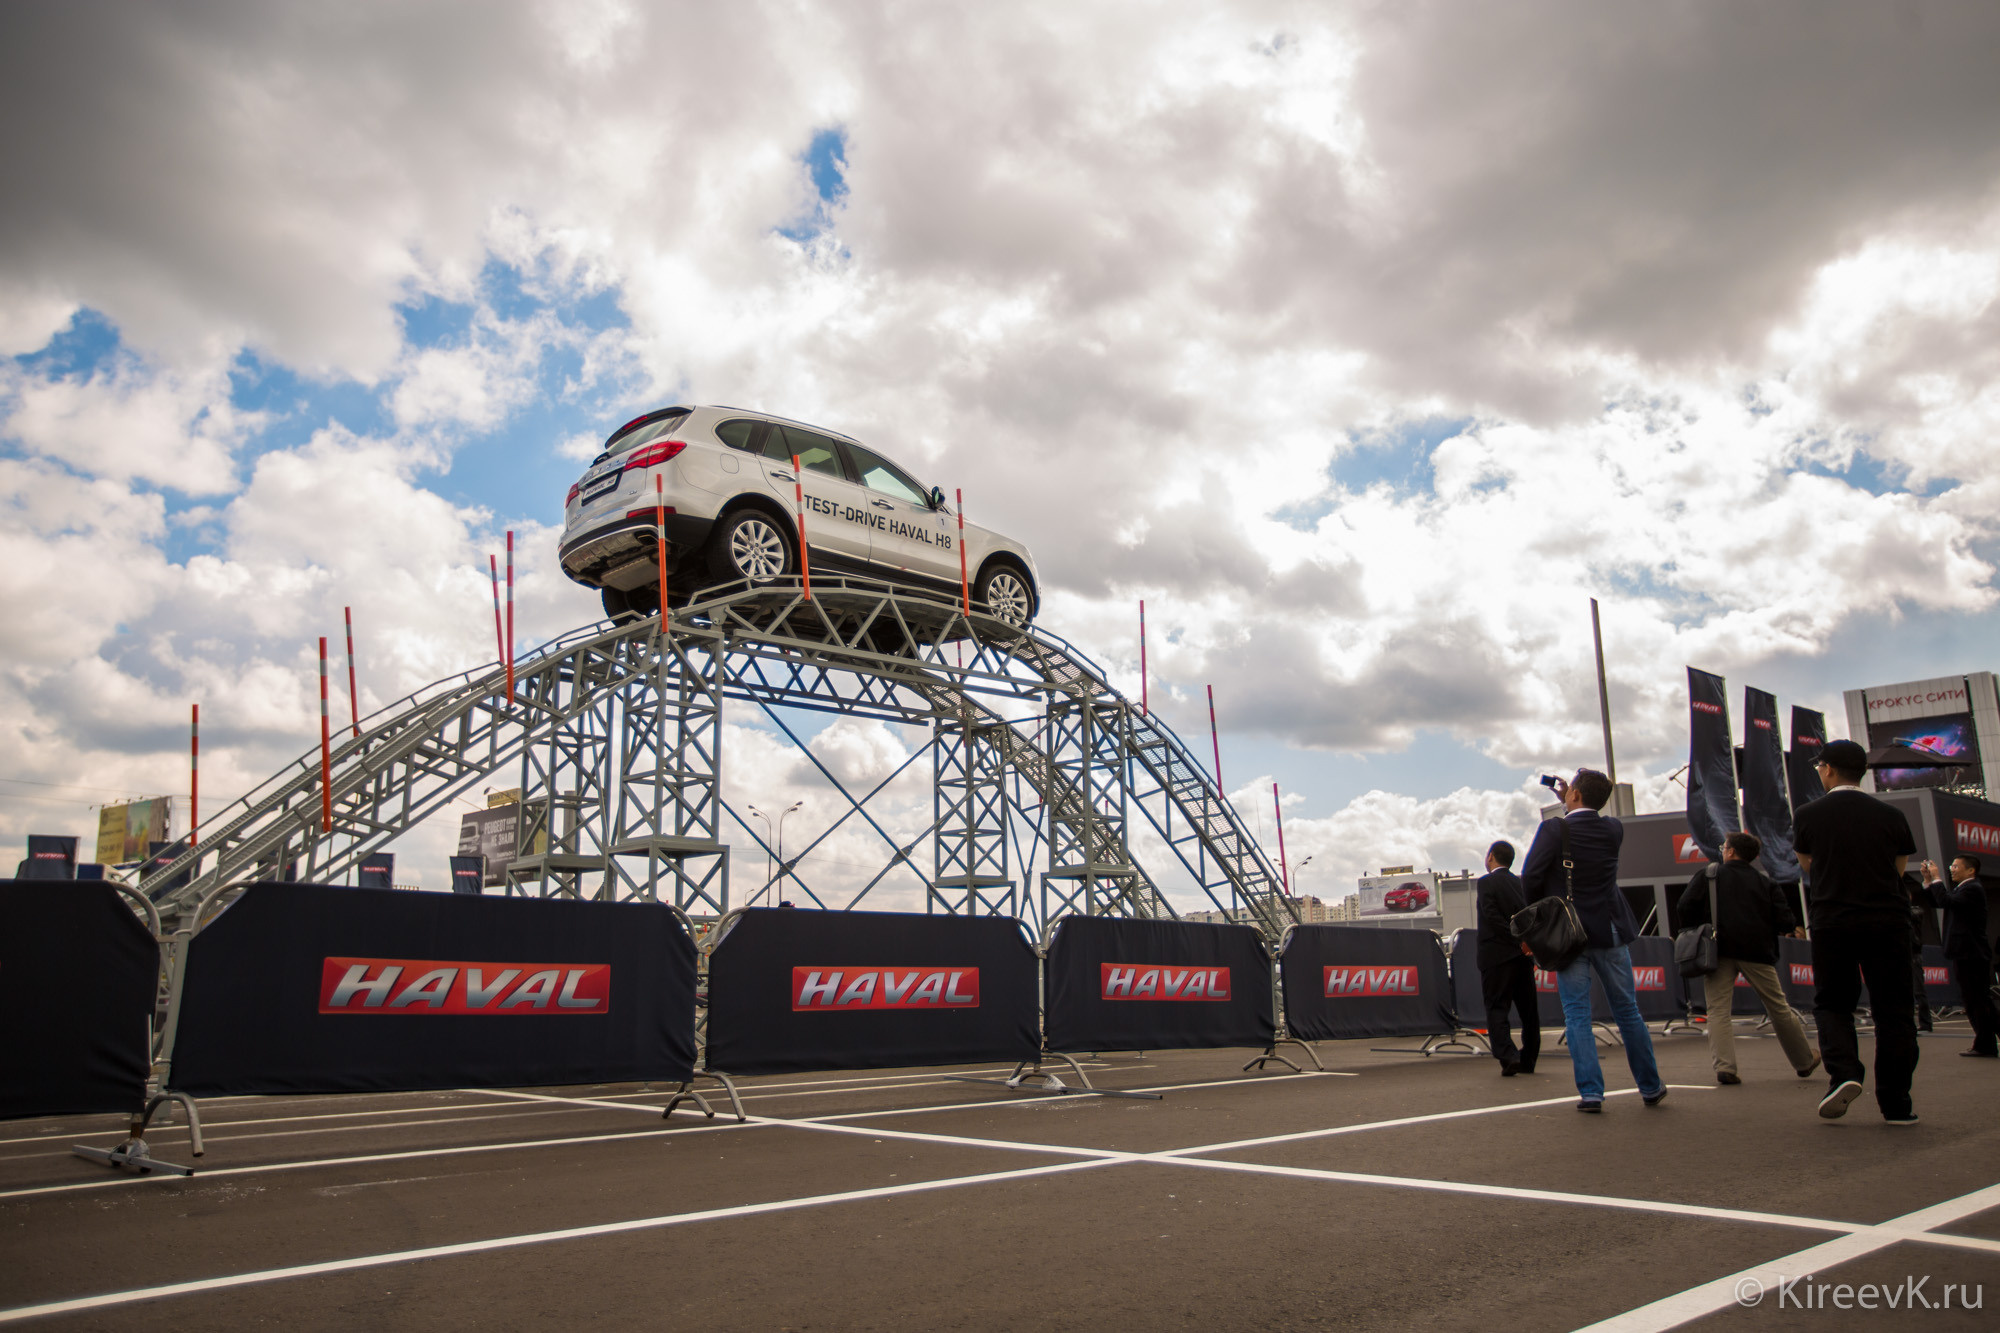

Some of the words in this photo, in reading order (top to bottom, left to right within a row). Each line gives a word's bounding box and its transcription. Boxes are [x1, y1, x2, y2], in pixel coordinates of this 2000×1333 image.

[804, 494, 886, 531] TEST-DRIVE
[889, 518, 932, 545] HAVAL
[935, 532, 952, 549] H8
[1868, 694, 1923, 710] КРОКУС
[1926, 689, 1965, 703] СИТИ
[484, 818, 506, 835] PEUGEOT
[1957, 823, 2000, 852] HAVA
[328, 964, 601, 1008] HAVAL
[1105, 968, 1227, 997] HAVAL
[1327, 969, 1416, 994] HAVAL
[1634, 969, 1664, 988] VAL
[1792, 966, 1814, 982] HAV
[798, 972, 974, 1006] HAVAL
